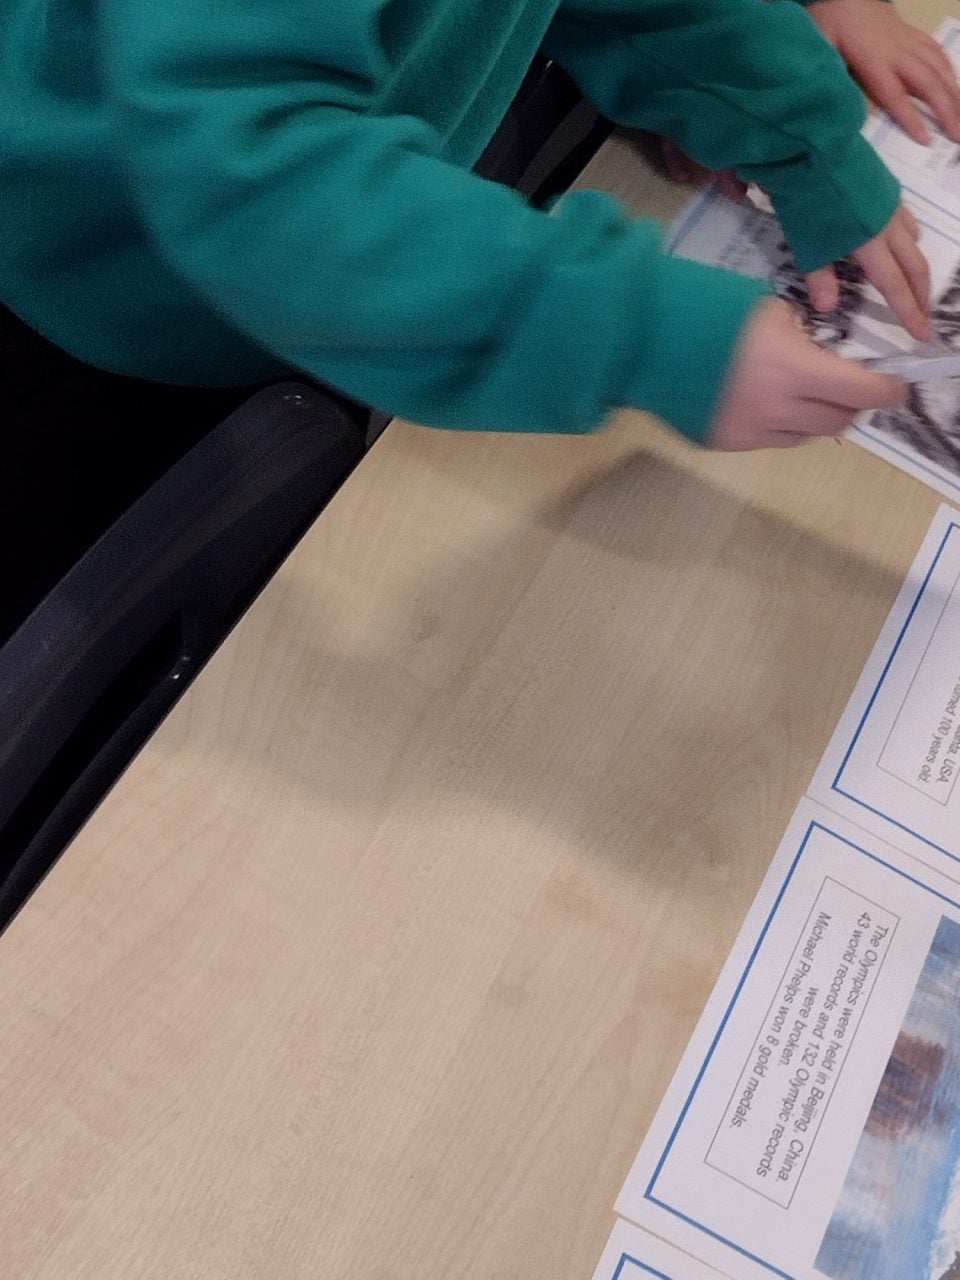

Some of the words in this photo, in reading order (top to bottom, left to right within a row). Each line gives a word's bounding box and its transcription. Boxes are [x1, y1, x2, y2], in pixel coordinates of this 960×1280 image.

[937, 716, 954, 737] 100
[925, 733, 944, 764] years
[801, 911, 832, 962] Michael
[857, 911, 872, 930] 43
[869, 924, 890, 948] The
[842, 929, 864, 966] world
[783, 959, 812, 1005] Phelps
[822, 963, 849, 1012] records
[846, 949, 878, 1007] Olympics
[798, 986, 820, 1019] were
[770, 1005, 791, 1034] won
[811, 1011, 830, 1041] and
[833, 1007, 854, 1040] were
[765, 1034, 780, 1047] 8
[777, 1019, 809, 1066] broken.
[800, 1041, 821, 1068] 132
[820, 1039, 844, 1073] held
[752, 1043, 773, 1079] gold
[814, 1070, 831, 1086] in
[729, 1076, 760, 1130] medals.
[778, 1067, 810, 1123] Olympic
[755, 1123, 786, 1178] records
